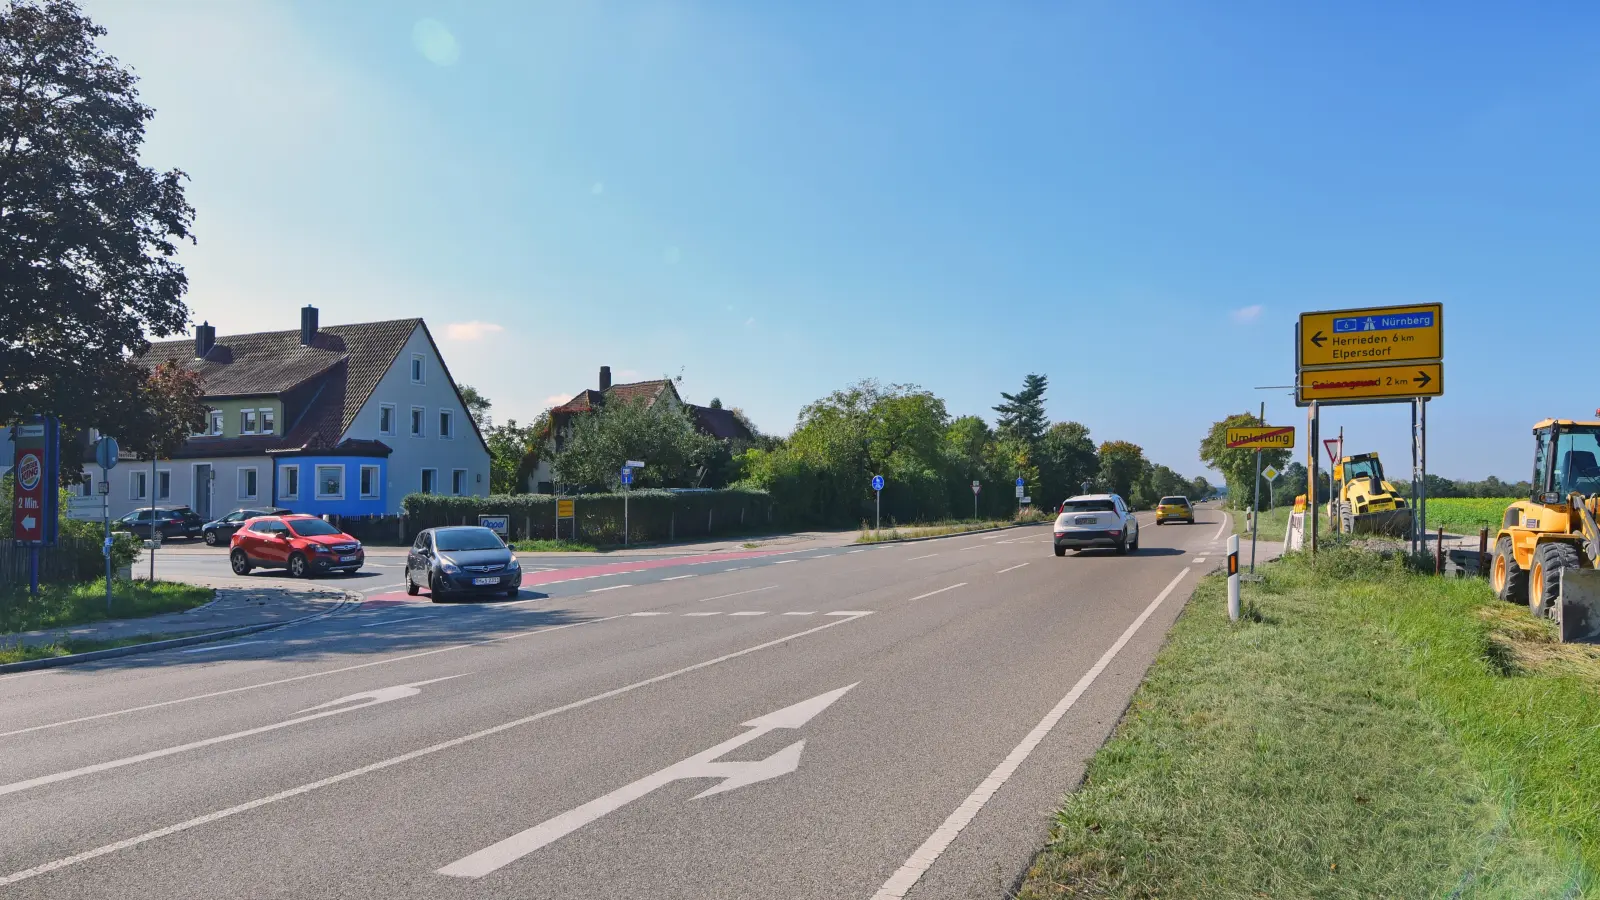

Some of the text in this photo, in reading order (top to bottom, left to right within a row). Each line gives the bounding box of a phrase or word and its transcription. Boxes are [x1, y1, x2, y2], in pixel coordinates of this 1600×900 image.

[1381, 316, 1431, 328] Nürnberg
[1332, 333, 1415, 347] Herrieden 6 km
[1332, 346, 1392, 359] Elpersdorf
[1386, 376, 1392, 386] 2
[21, 467, 38, 482] KING
[18, 497, 39, 509] 2 Min.
